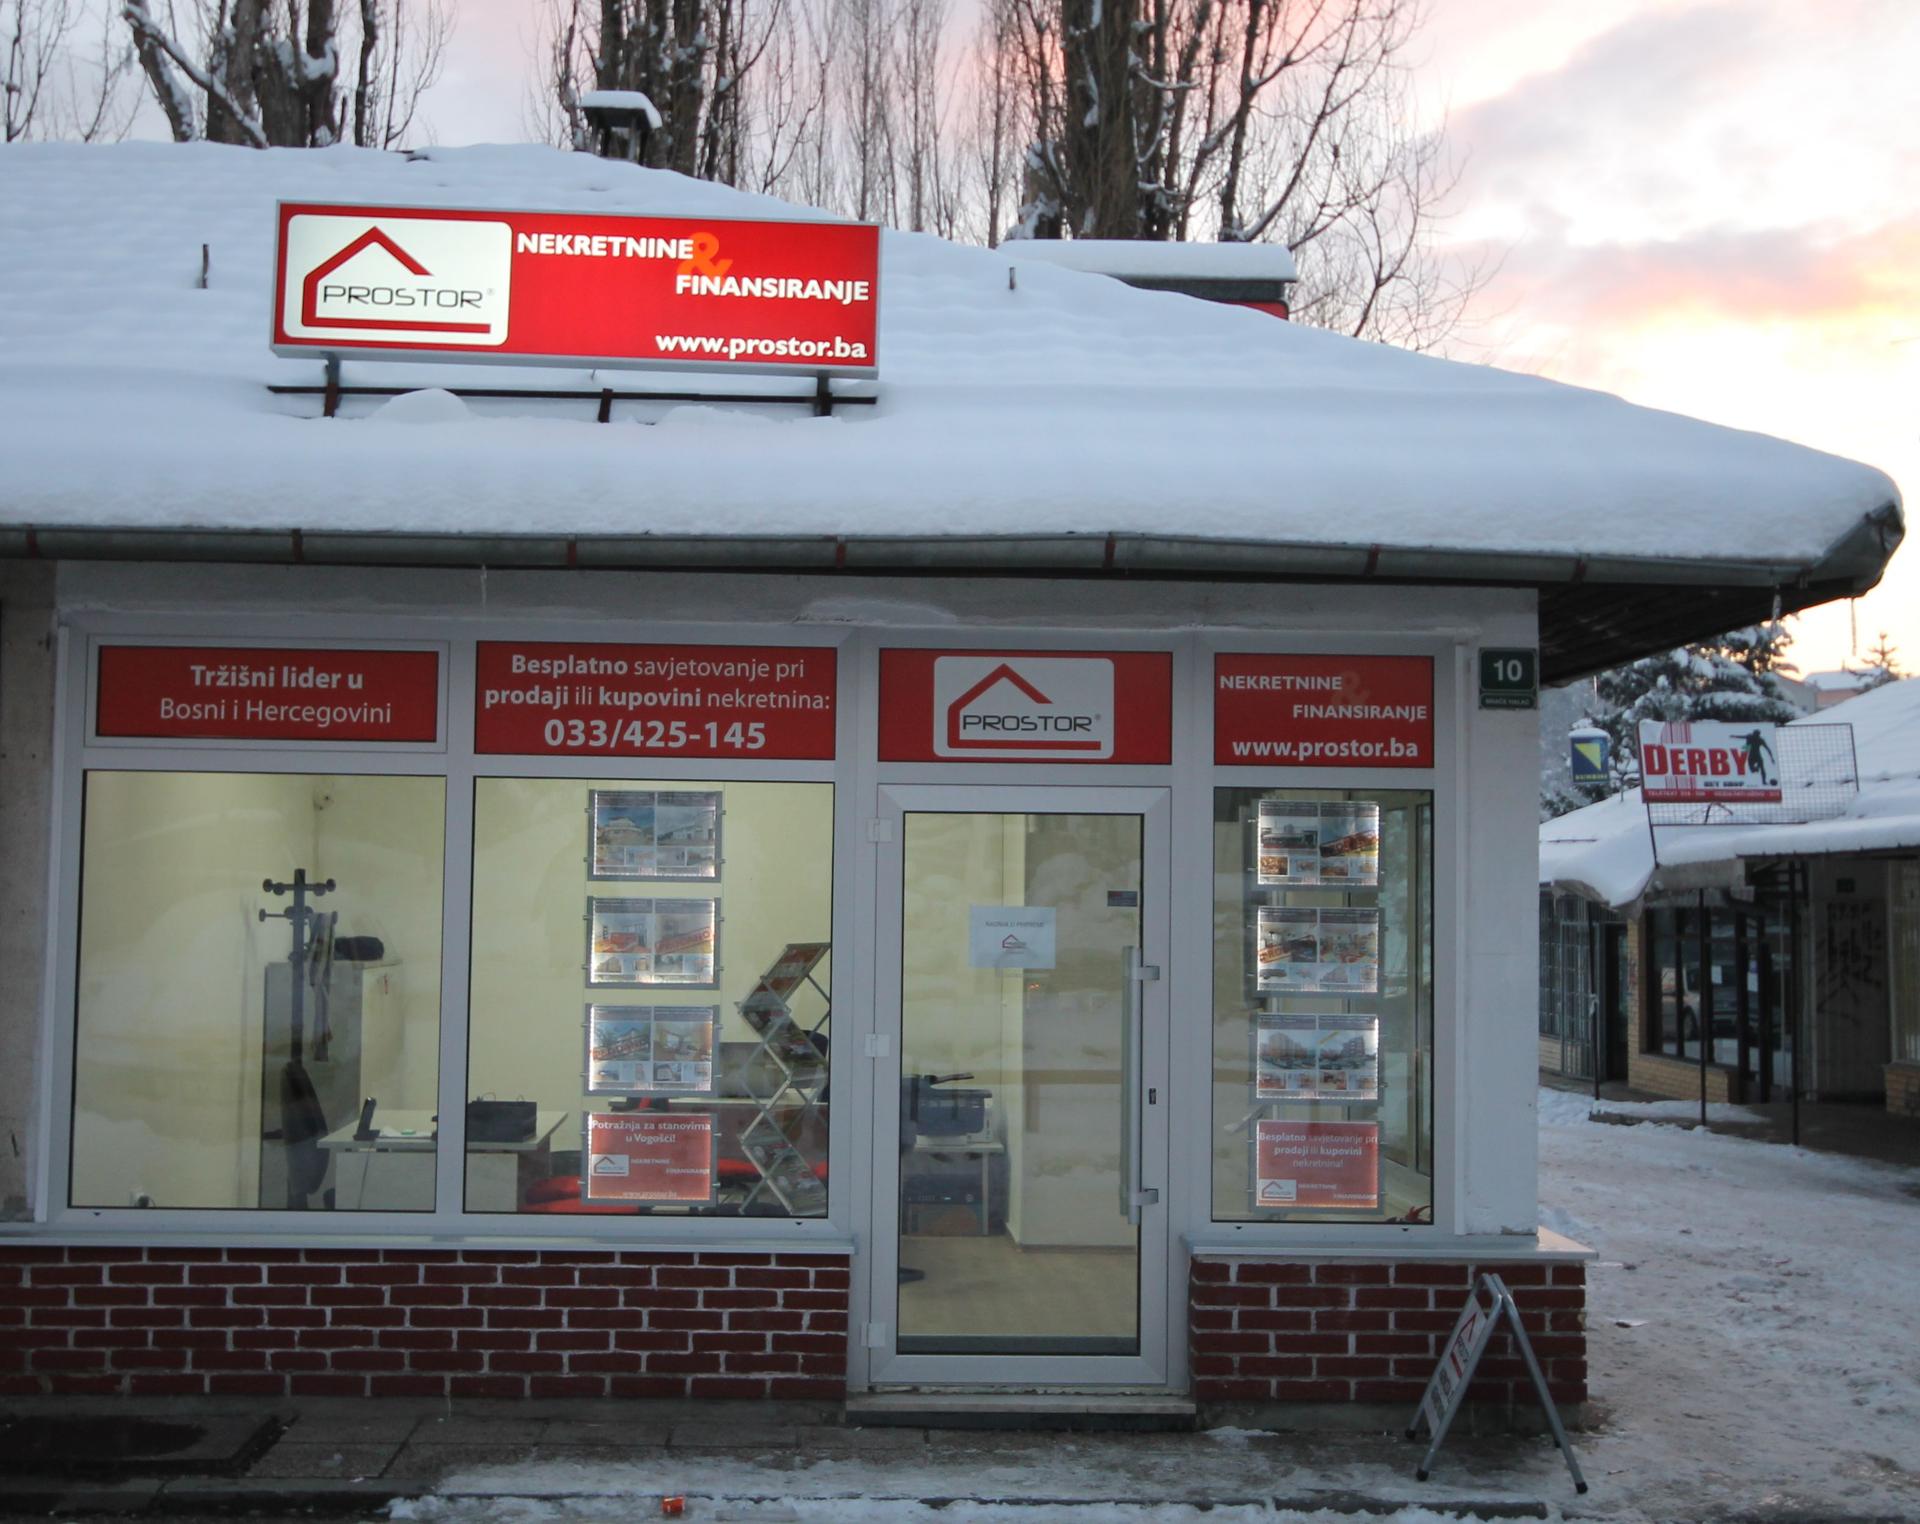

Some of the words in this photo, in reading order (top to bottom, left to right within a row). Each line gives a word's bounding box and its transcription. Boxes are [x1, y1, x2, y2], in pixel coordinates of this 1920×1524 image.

[517, 233, 694, 260] NEKRETNINE
[323, 284, 483, 309] PROSTOR
[676, 275, 869, 305] FINANSIRANJE
[655, 334, 867, 360] www.prostor.ba
[191, 664, 276, 689] Tržišni
[282, 666, 341, 689] lider
[348, 673, 363, 690] u
[511, 655, 628, 679] Besplatno
[634, 657, 770, 681] savjetovanje
[776, 659, 804, 682] pri
[1493, 659, 1522, 682] 10
[1220, 675, 1342, 691] NEKRETNINE
[485, 686, 569, 709] prodaji
[575, 687, 592, 705] ili
[599, 687, 701, 709] kupovini
[707, 688, 830, 709] nekretnina:
[160, 698, 225, 720] Bosni
[232, 700, 238, 720] i
[246, 700, 391, 728] Hercegovini
[962, 714, 1092, 732] PROSTOR
[1293, 704, 1427, 721] FINANSIRANJE
[544, 719, 766, 749] 033/425-145
[1232, 738, 1418, 760] www.prostor.ba
[1643, 743, 1749, 776] DERBY
[644, 1122, 655, 1130] za
